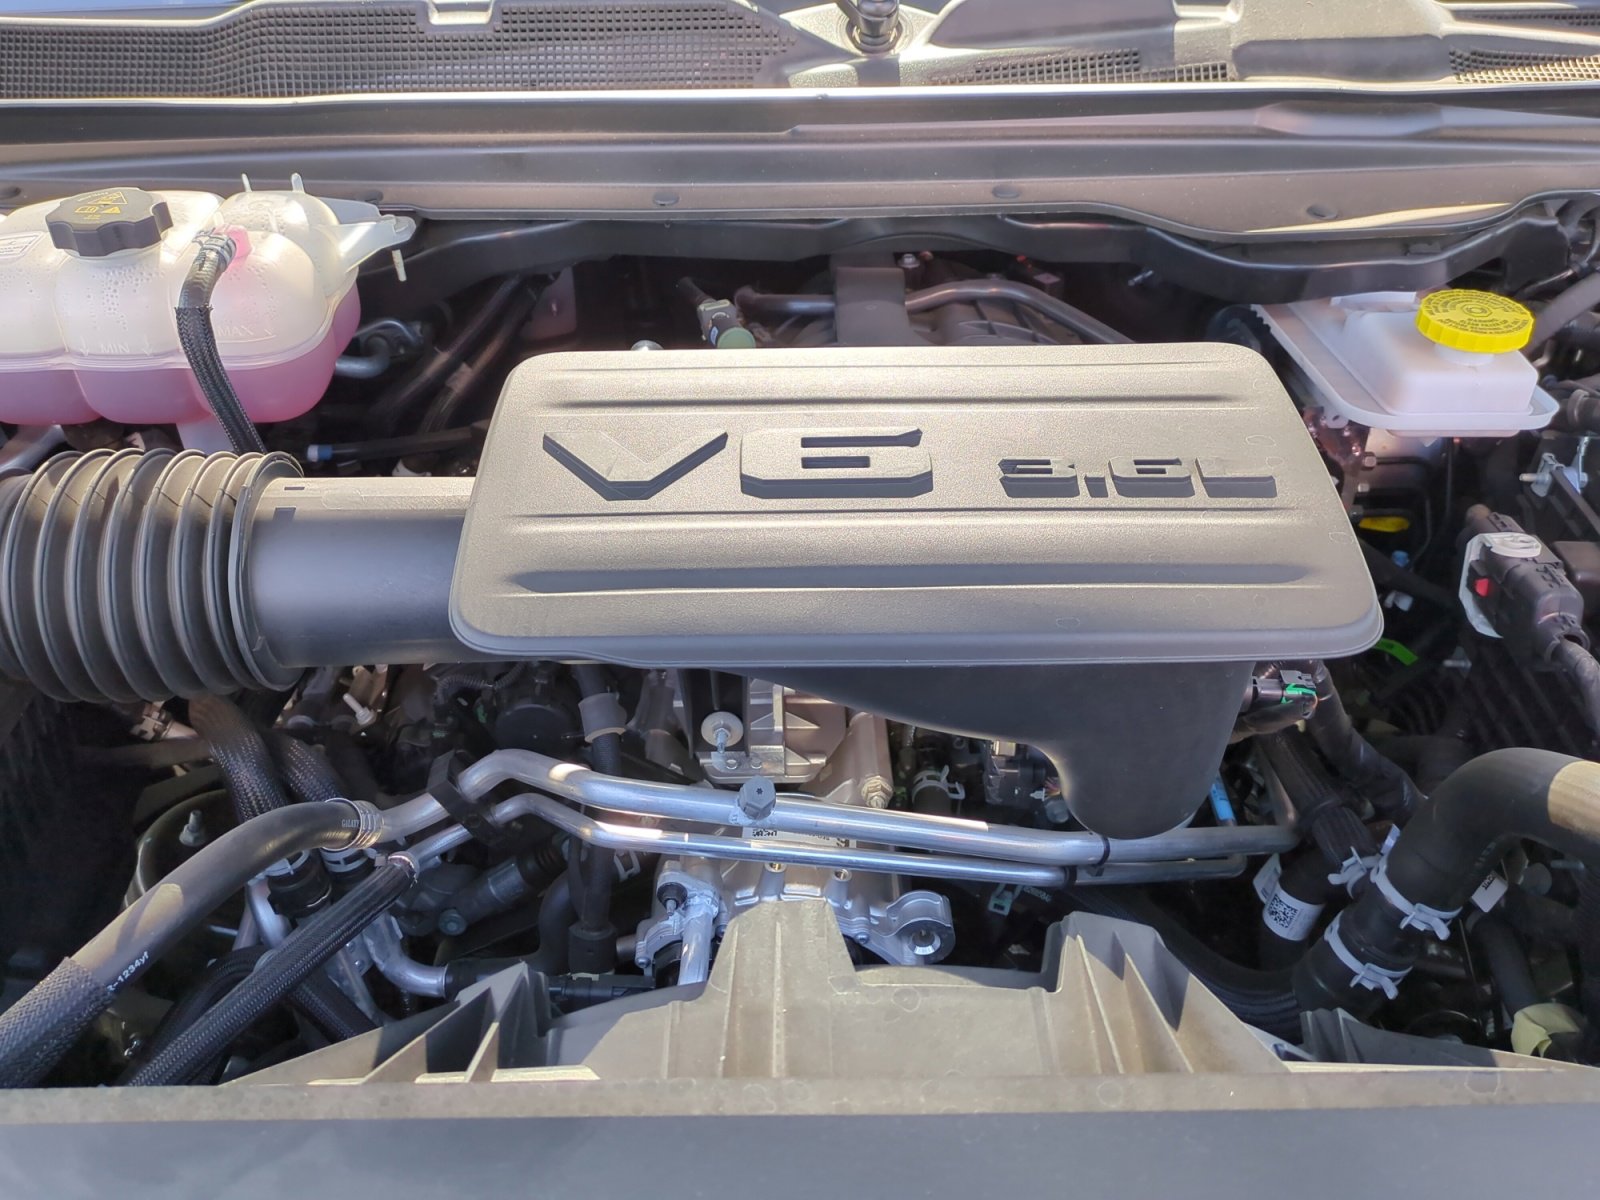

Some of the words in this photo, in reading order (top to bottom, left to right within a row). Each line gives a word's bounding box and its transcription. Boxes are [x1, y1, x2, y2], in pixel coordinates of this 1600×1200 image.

[217, 325, 253, 337] MAX
[101, 343, 131, 355] MIN
[543, 426, 934, 501] V6
[997, 455, 1278, 499] 3.6L
